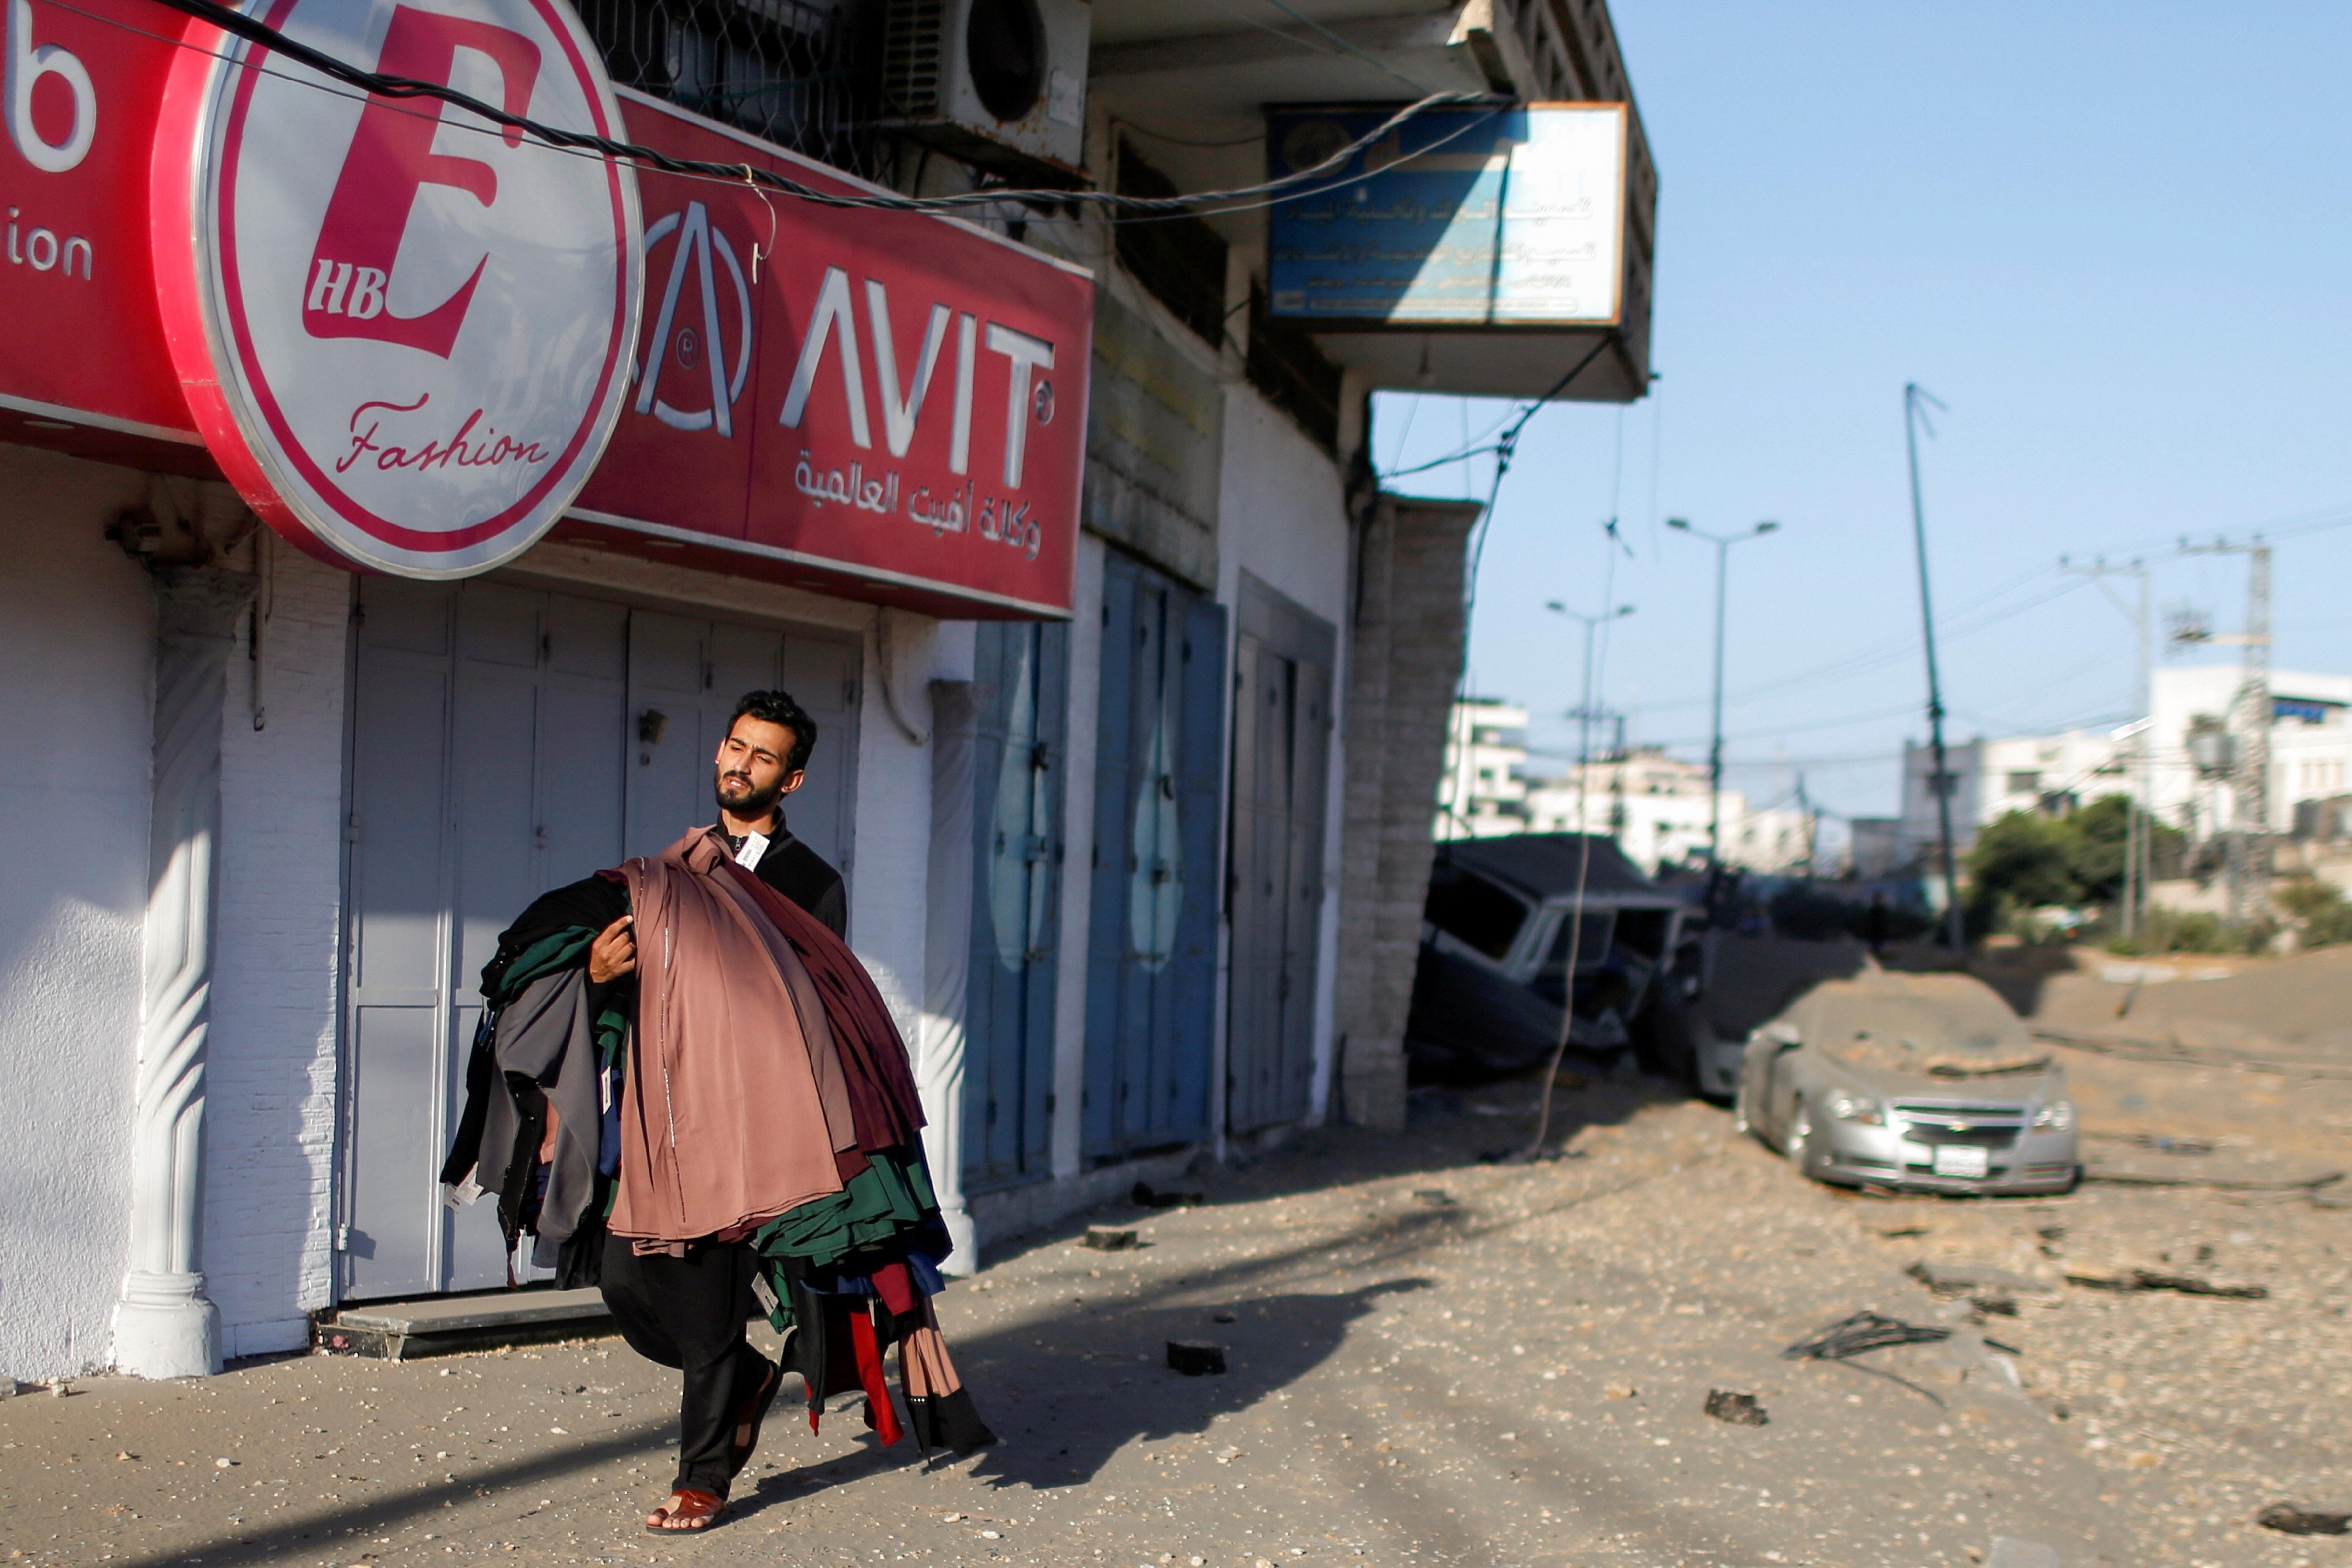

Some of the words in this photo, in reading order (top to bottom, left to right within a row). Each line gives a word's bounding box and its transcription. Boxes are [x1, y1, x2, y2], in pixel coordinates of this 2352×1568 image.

[8, 205, 93, 280] ion
[307, 258, 387, 320] HB
[779, 264, 1055, 489] AVIT
[336, 393, 549, 473] Fashion
[795, 448, 900, 515] العالمية
[979, 497, 1041, 561] وكالة
